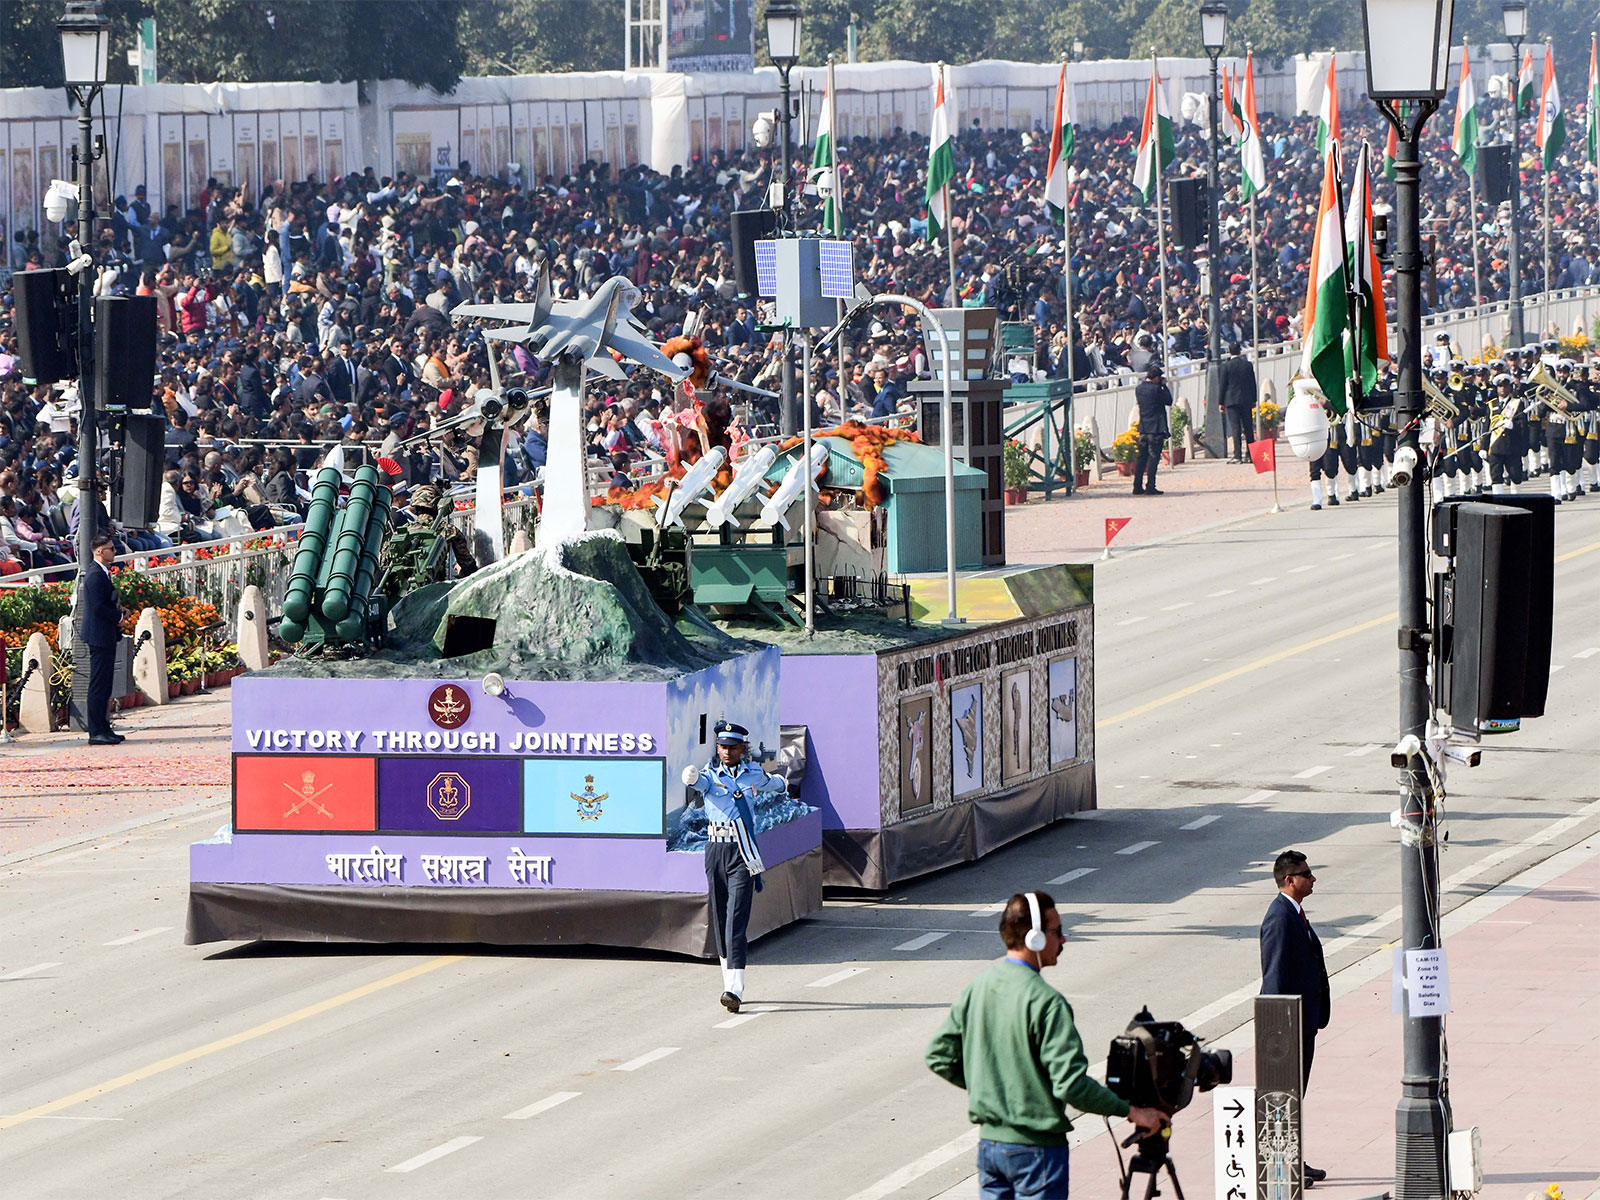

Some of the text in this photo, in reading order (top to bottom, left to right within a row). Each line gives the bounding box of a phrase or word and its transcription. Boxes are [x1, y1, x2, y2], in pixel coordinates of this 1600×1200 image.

[954, 641, 993, 676] VICTORY
[995, 630, 1034, 665] THROUGH
[1036, 618, 1078, 655] JOINTNESS
[246, 730, 653, 752] VICTORY THROUGH JOINTNESS
[325, 845, 552, 883] भारतीय सशस्त्र सेना
